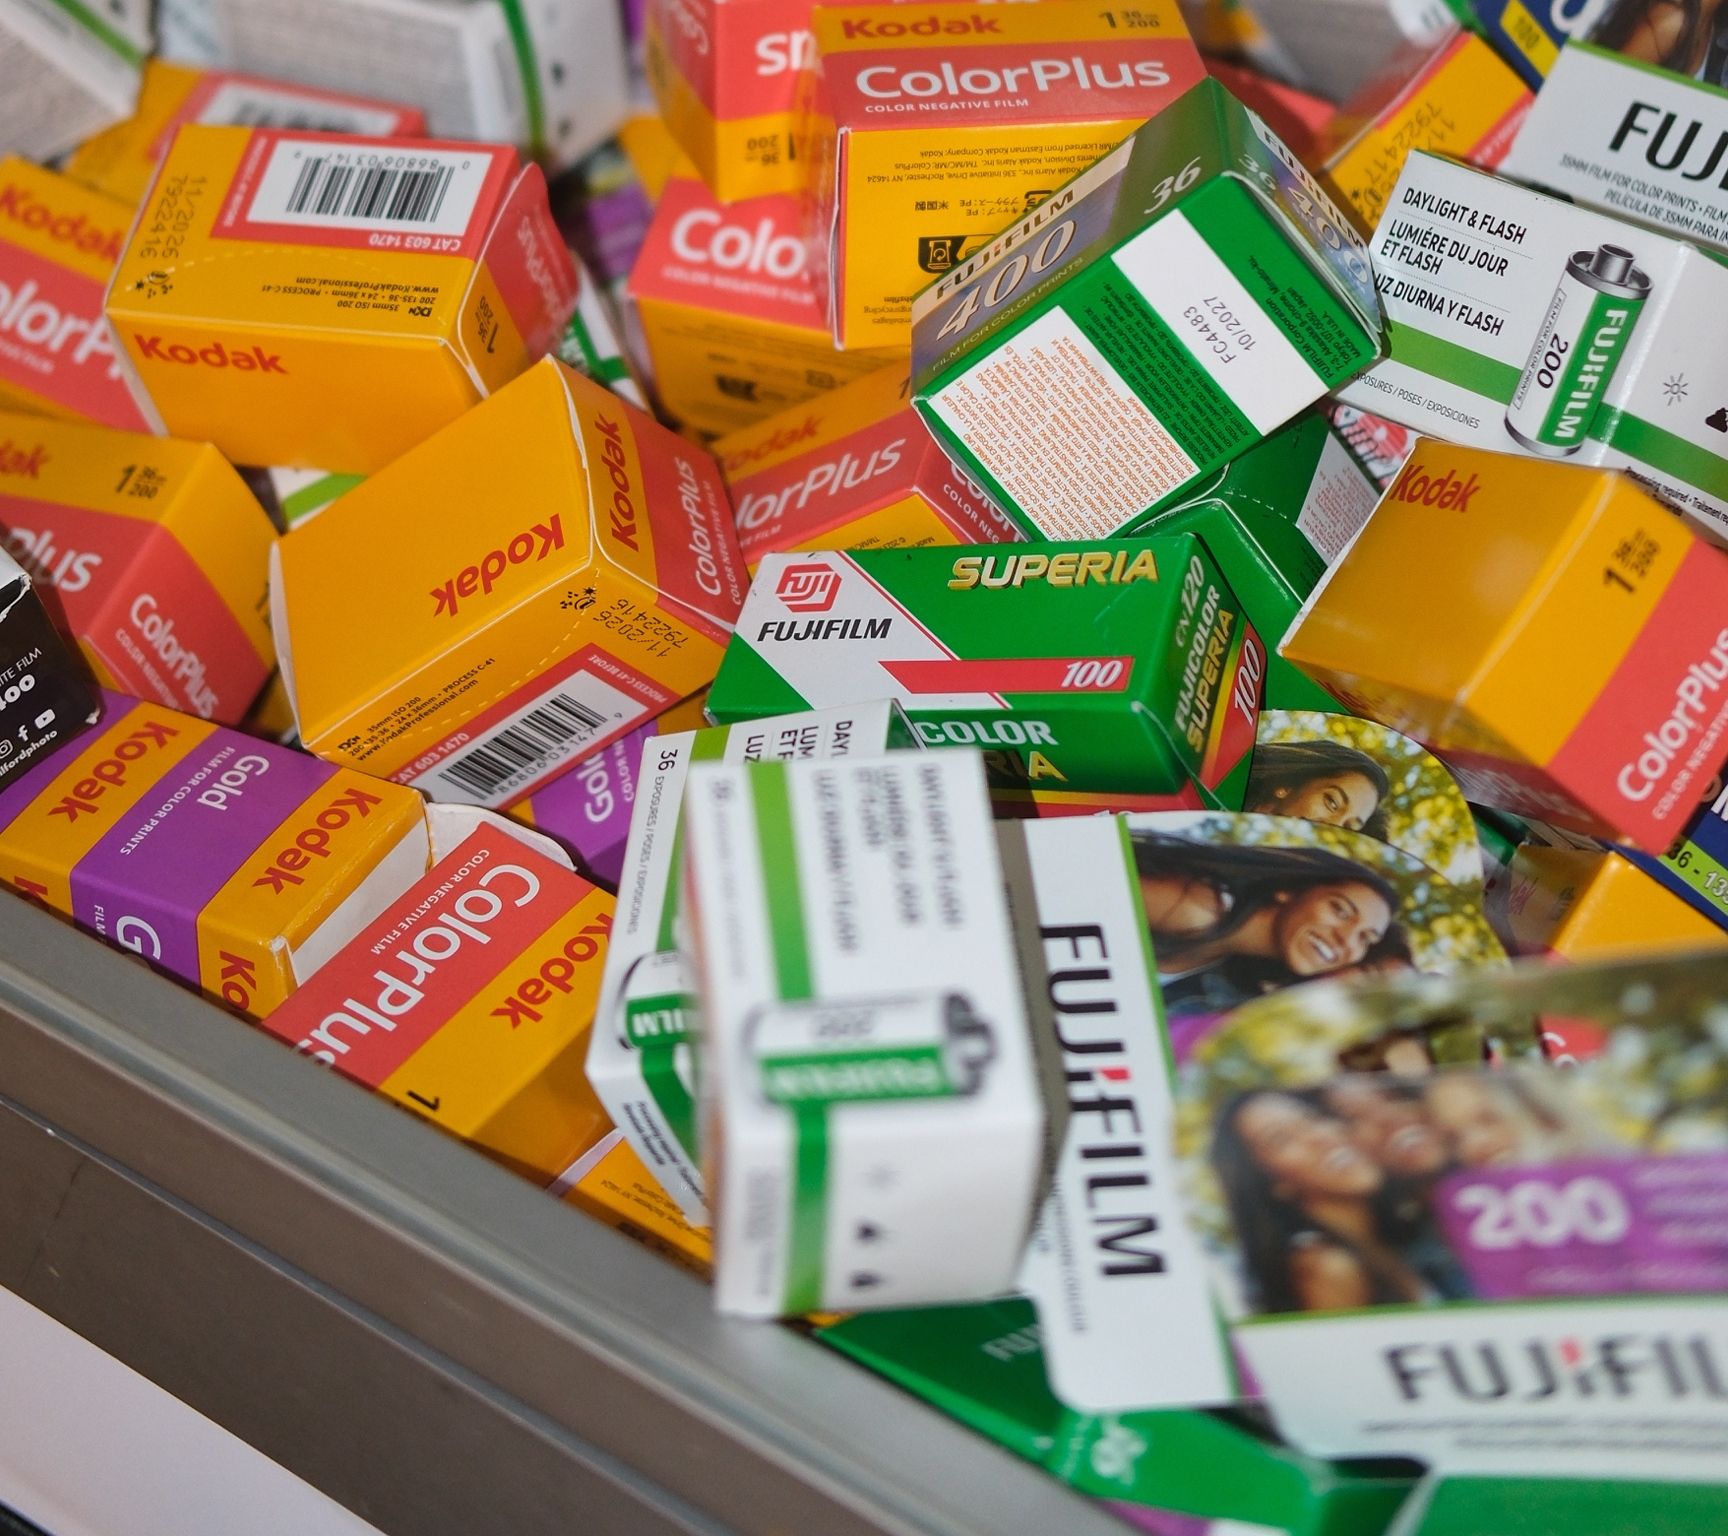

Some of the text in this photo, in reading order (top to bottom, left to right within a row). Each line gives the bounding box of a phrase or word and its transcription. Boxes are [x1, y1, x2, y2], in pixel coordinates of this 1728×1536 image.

[840, 13, 1003, 41] Kodak
[854, 58, 1171, 101] ColorPlus
[864, 96, 1029, 114] COLOR NEGATIVE FILM
[1142, 155, 1203, 216] 36
[1237, 156, 1278, 192] 36
[1588, 164, 1612, 182] FILM
[1611, 170, 1632, 187] FOR
[1631, 179, 1662, 200] COLOR
[1663, 187, 1698, 213] PRINTS
[367, 231, 462, 251] CAT 603 1470
[1285, 184, 1370, 287] 400
[1402, 187, 1527, 244] DAYLIGHT & FLASH
[1650, 203, 1664, 218] DE
[1663, 208, 1694, 230] 35MM
[1692, 218, 1719, 239] PARA
[936, 188, 1076, 300] FUJIFILM
[1380, 239, 1444, 276] ET FLASH
[1388, 219, 1509, 277] LUMIÉRE DU JOUR
[935, 218, 1078, 342] 400
[1181, 302, 1237, 365] FC4483
[1201, 290, 1258, 353] 10/2027
[1392, 282, 1505, 336] DIURNA Y FLASH
[134, 333, 289, 376] Kodak
[1536, 334, 1569, 390] 200
[1554, 308, 1628, 440] FUJIFILM
[1398, 390, 1480, 430] POSES EXPOSICIONES
[593, 414, 640, 552] Kodak
[735, 437, 908, 533] lorPlus
[1390, 464, 1481, 513] Kodak
[1662, 485, 1722, 519] required Traitement
[675, 457, 722, 596] ColorPlus
[712, 508, 730, 565] NEGATIVE
[429, 514, 565, 618] Kodak
[724, 566, 741, 605] COLOR
[947, 548, 1159, 591] SUPERIA
[1180, 555, 1206, 611] 120
[757, 617, 893, 643] FUJIFILM
[1174, 582, 1221, 730] FUJICOLOR
[13, 645, 43, 676] FILM
[1059, 658, 1124, 689] 100
[1187, 609, 1234, 753] SUPERIA
[1234, 639, 1261, 726] 100
[410, 730, 473, 771] 603 1470
[657, 749, 678, 771] 36
[781, 730, 798, 746] ET
[919, 718, 1059, 746] COLOR
[48, 721, 179, 823] Kodak
[197, 754, 270, 812] Gold
[114, 745, 238, 857] FILM FOR COLOR PRINTS
[252, 787, 384, 896] Kodak
[368, 847, 492, 956] COLOR NEGATIVE FILM
[487, 912, 614, 1031] Kodak
[405, 1089, 441, 1113] 1
[1040, 921, 1170, 1278] FUJIFILM
[1452, 1177, 1633, 1251] 200
